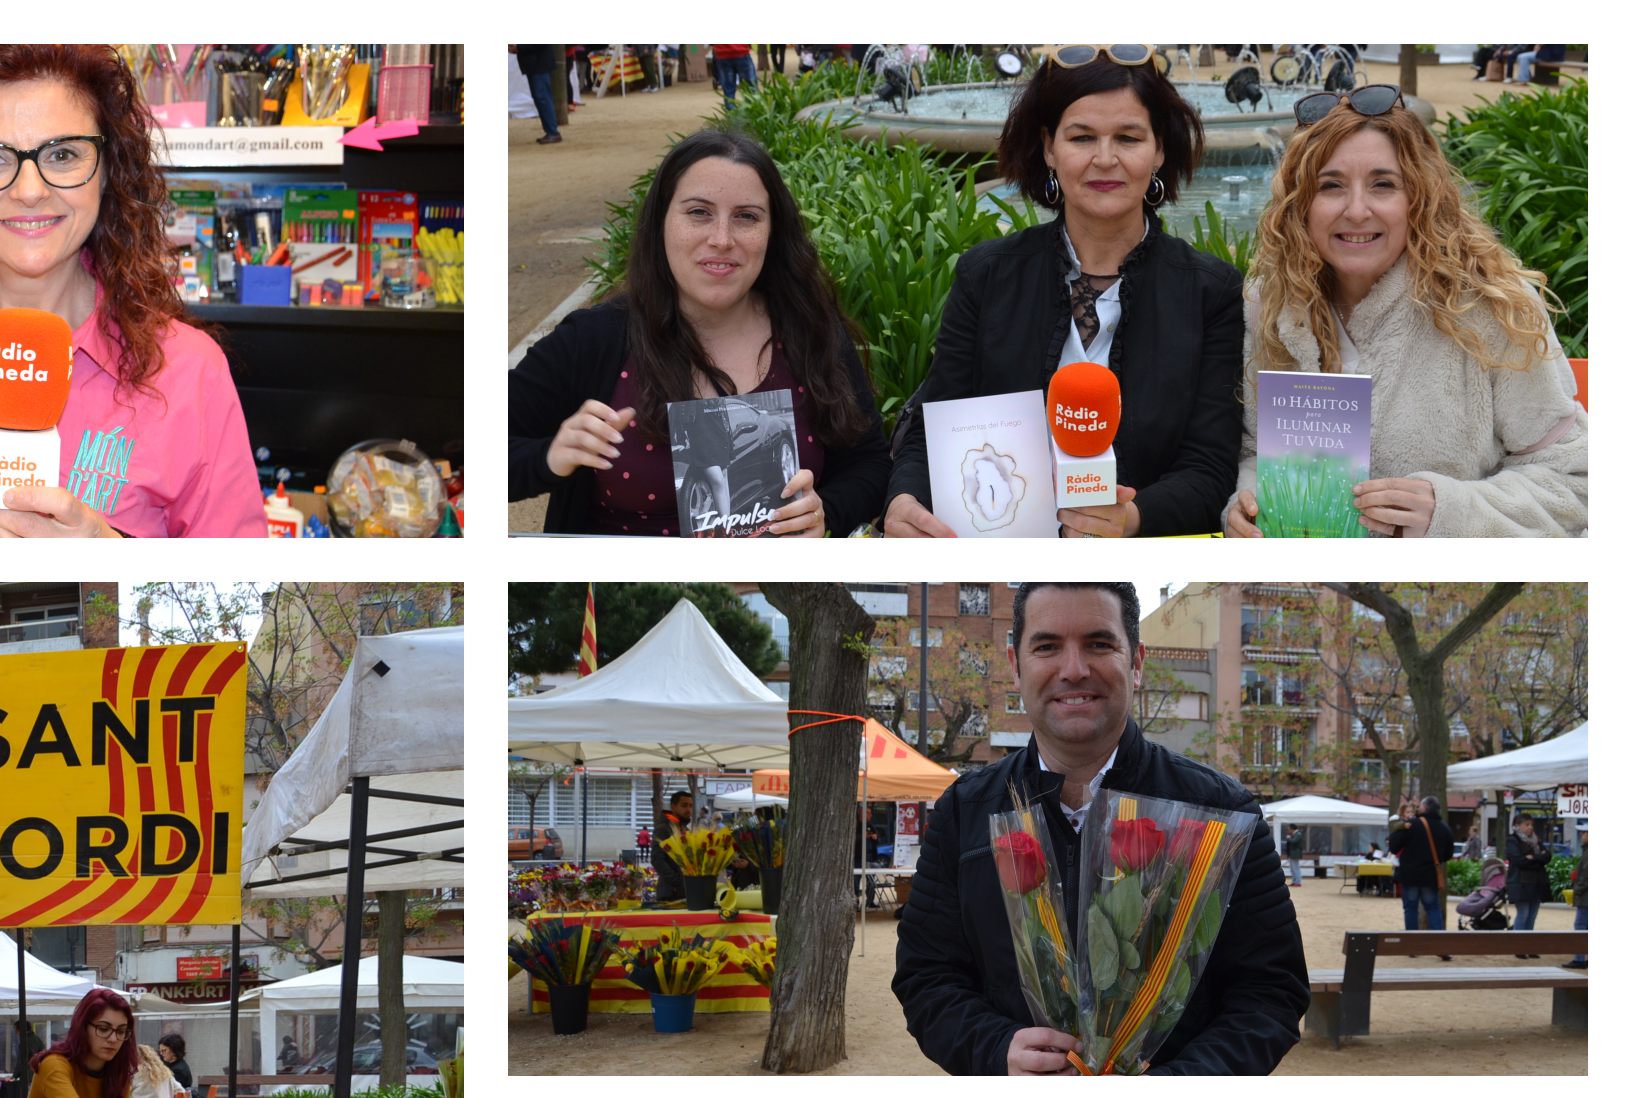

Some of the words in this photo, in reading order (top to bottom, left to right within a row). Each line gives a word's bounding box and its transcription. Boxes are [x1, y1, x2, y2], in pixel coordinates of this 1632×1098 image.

[1056, 403, 1098, 419] Ràdio
[1272, 396, 1286, 407] 10
[1289, 395, 1359, 412] HÁBITOS
[988, 420, 999, 429] del
[1000, 419, 1023, 429] Fuego
[1055, 416, 1108, 431] Pineda
[1276, 417, 1352, 434] ILUMINAR
[1282, 433, 1305, 446] TU
[1306, 435, 1345, 449] VIDA
[73, 426, 135, 477] MÓN
[1066, 474, 1101, 484] Ràdio
[66, 470, 129, 515] D'ART
[1066, 484, 1108, 494] Pineda
[1562, 784, 1588, 798] SA
[129, 986, 226, 999] FRANKFURT
